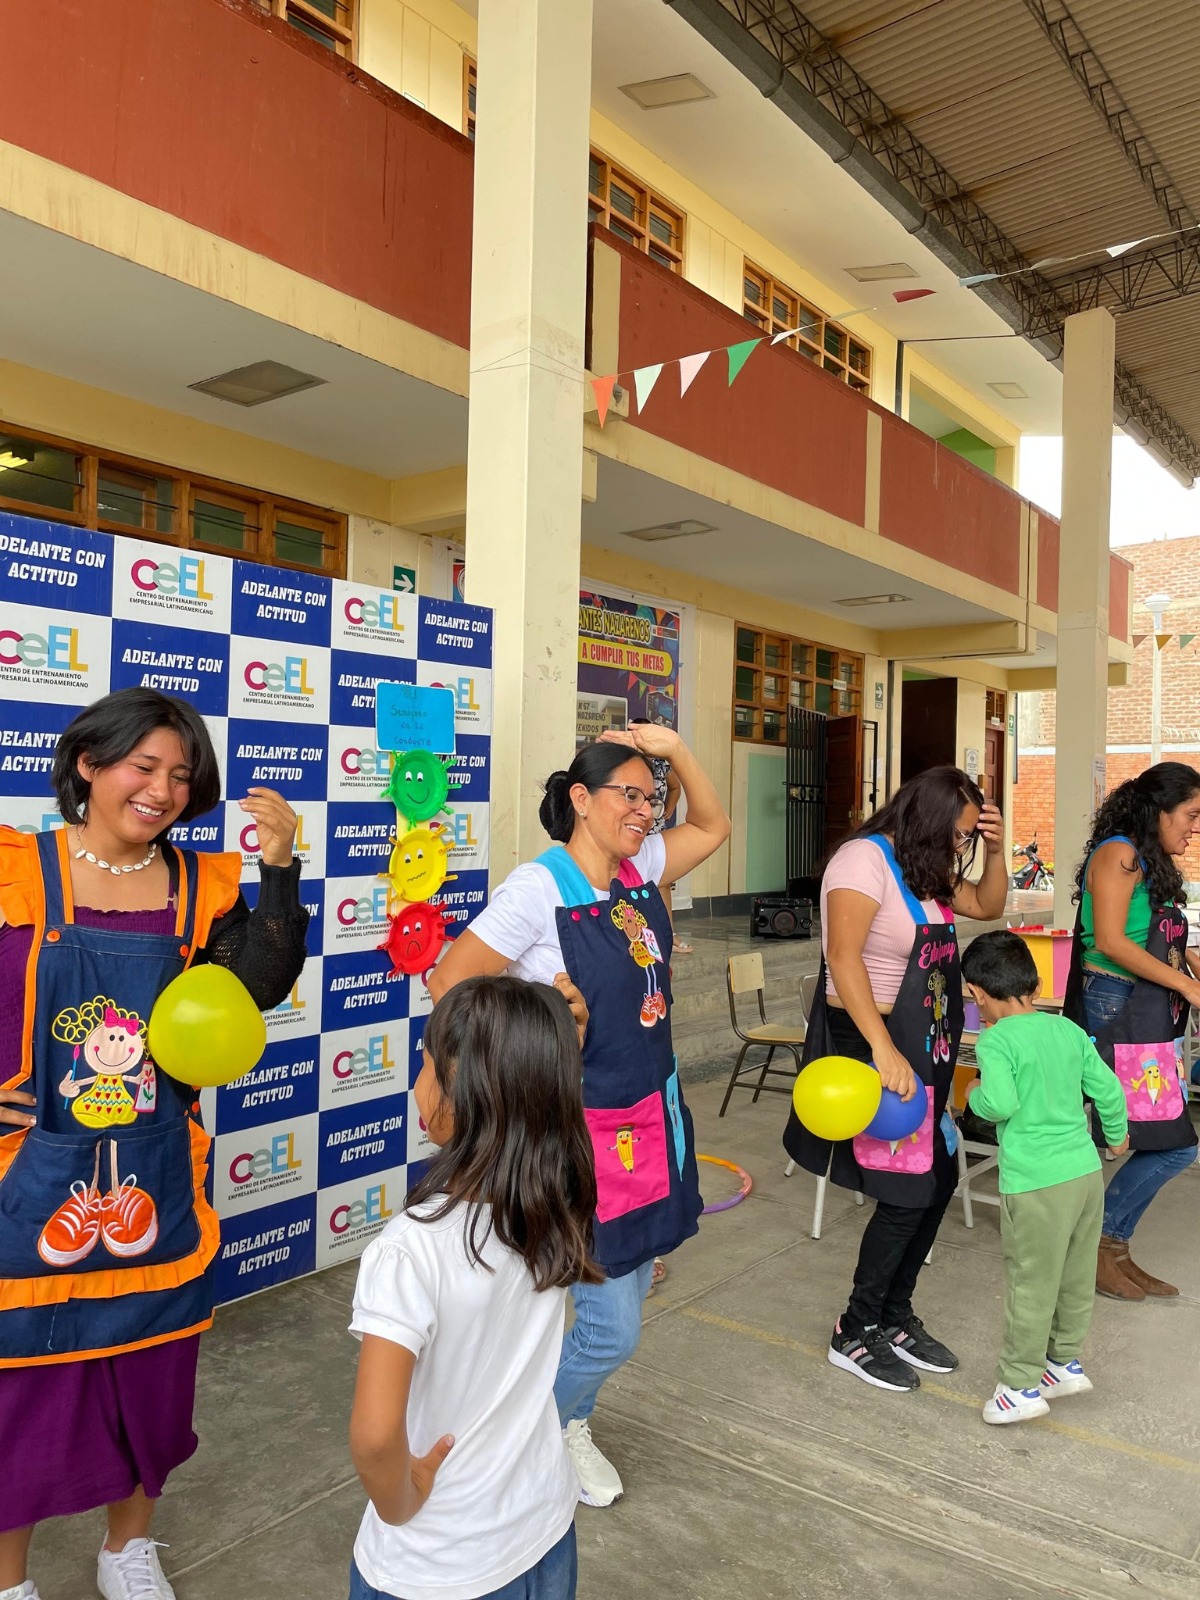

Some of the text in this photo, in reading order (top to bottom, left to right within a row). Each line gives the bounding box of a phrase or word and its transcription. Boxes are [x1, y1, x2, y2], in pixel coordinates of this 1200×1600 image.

[0, 535, 106, 569] DELANTE CON
[8, 562, 78, 587] ACTITUD
[136, 591, 157, 600] CENTRO
[241, 580, 327, 607] ADELANTE CON
[256, 604, 307, 624] ACTITUD
[425, 613, 488, 634] ADELANTE CON
[603, 612, 650, 642] NAZARENOS
[436, 633, 473, 649] ACTITUD
[122, 648, 223, 673] ADELANTE CON
[582, 642, 664, 672] A CUMPLIR TUS METAS
[0, 666, 21, 674] ENTRO
[140, 673, 199, 692] ACTITUD
[352, 695, 375, 708] ACTI
[236, 744, 323, 761] ADELANTE CON
[469, 755, 486, 768] CON
[252, 766, 303, 780] ACTITUD
[447, 772, 472, 785] TITUD
[191, 826, 218, 841] CON
[334, 825, 388, 838] ADELANTE
[348, 843, 392, 857] ACTITUD
[467, 890, 484, 903] CON
[330, 972, 384, 992] ADELANTE
[343, 991, 388, 1010] ACTITUD
[291, 1060, 315, 1077] CON
[242, 1084, 294, 1109] ACTITUD
[326, 1121, 381, 1148] ADELANTE
[383, 1115, 403, 1132] CON
[339, 1139, 385, 1164] ACTITUD
[221, 1218, 311, 1260] ADELANTE CON
[238, 1246, 291, 1276] ACTITUD
